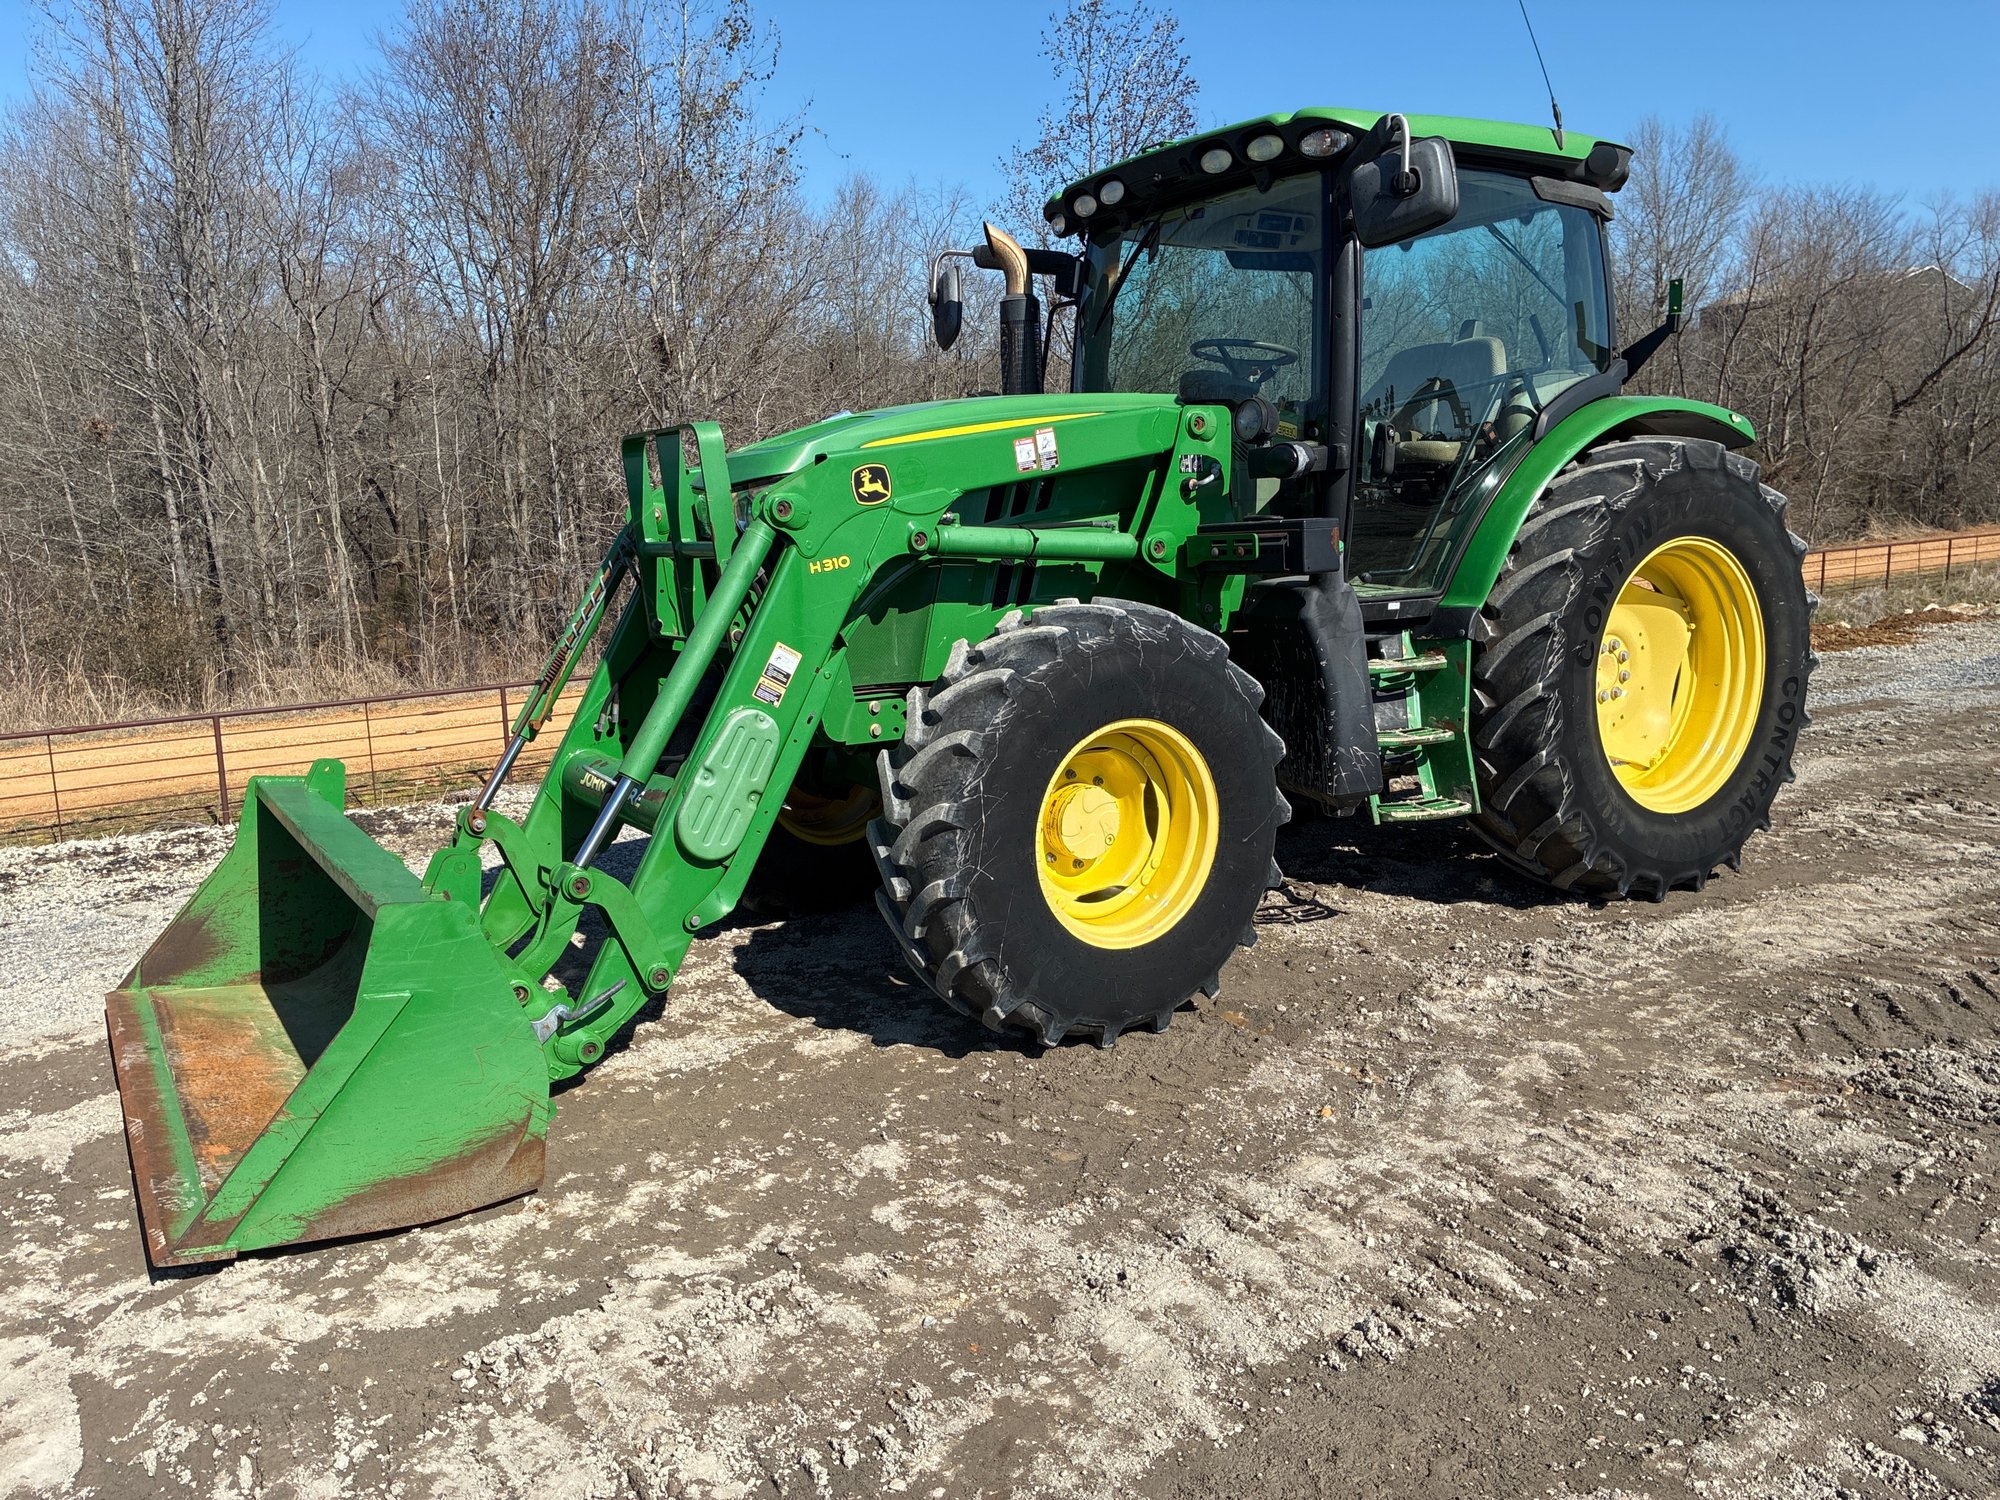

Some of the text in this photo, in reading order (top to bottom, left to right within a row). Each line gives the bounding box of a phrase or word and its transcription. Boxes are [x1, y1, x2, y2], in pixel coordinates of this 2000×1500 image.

[809, 555, 851, 574] H310
[1717, 676, 1800, 840] CONTRACT
[580, 771, 607, 793] JOHN
